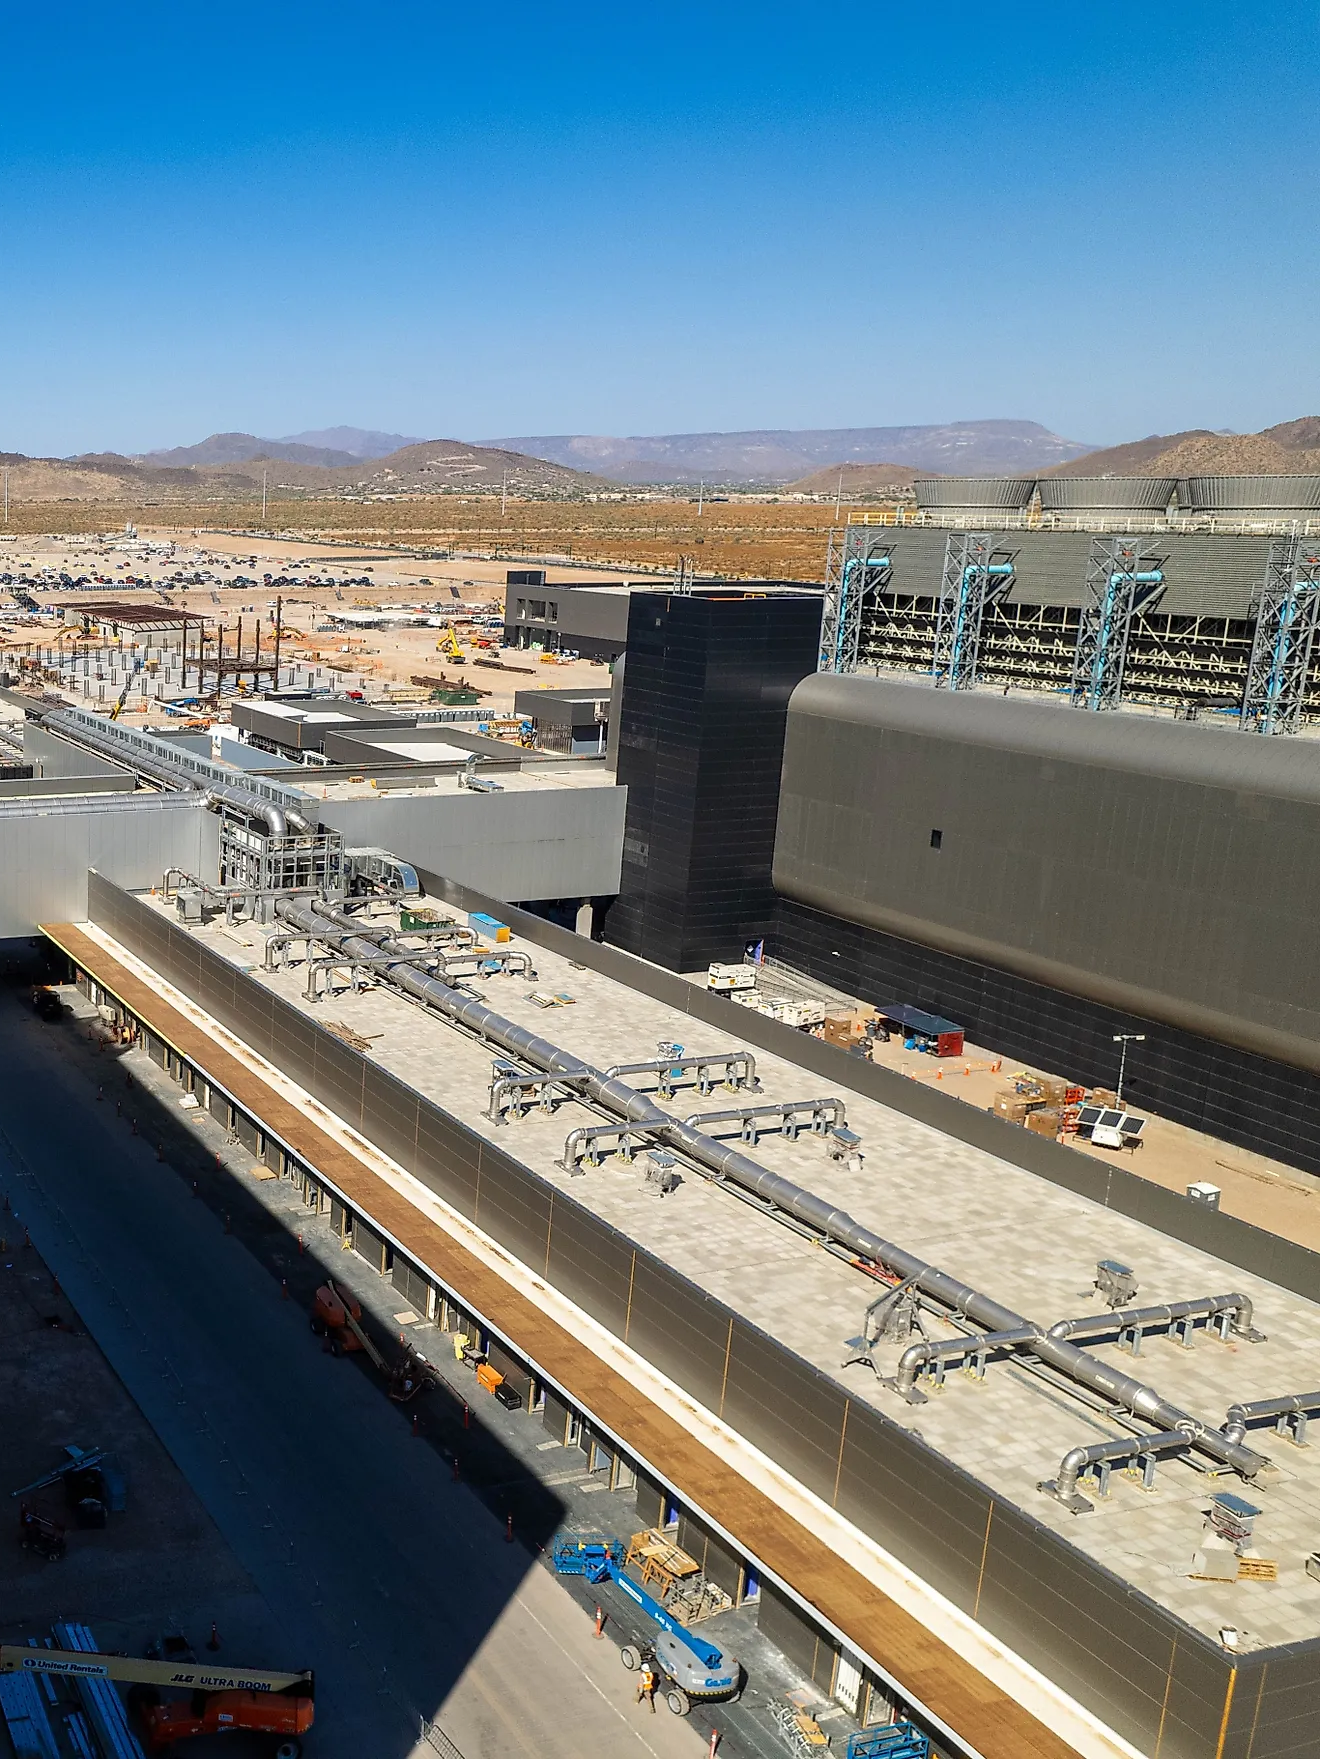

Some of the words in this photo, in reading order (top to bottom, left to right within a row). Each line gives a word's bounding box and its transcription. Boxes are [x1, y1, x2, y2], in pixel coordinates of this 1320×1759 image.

[38, 1661, 68, 1671] United
[70, 1664, 104, 1674] Rentals
[170, 1674, 195, 1683] JLG
[200, 1676, 234, 1688] ULTRA
[237, 1680, 272, 1692] BOOM
